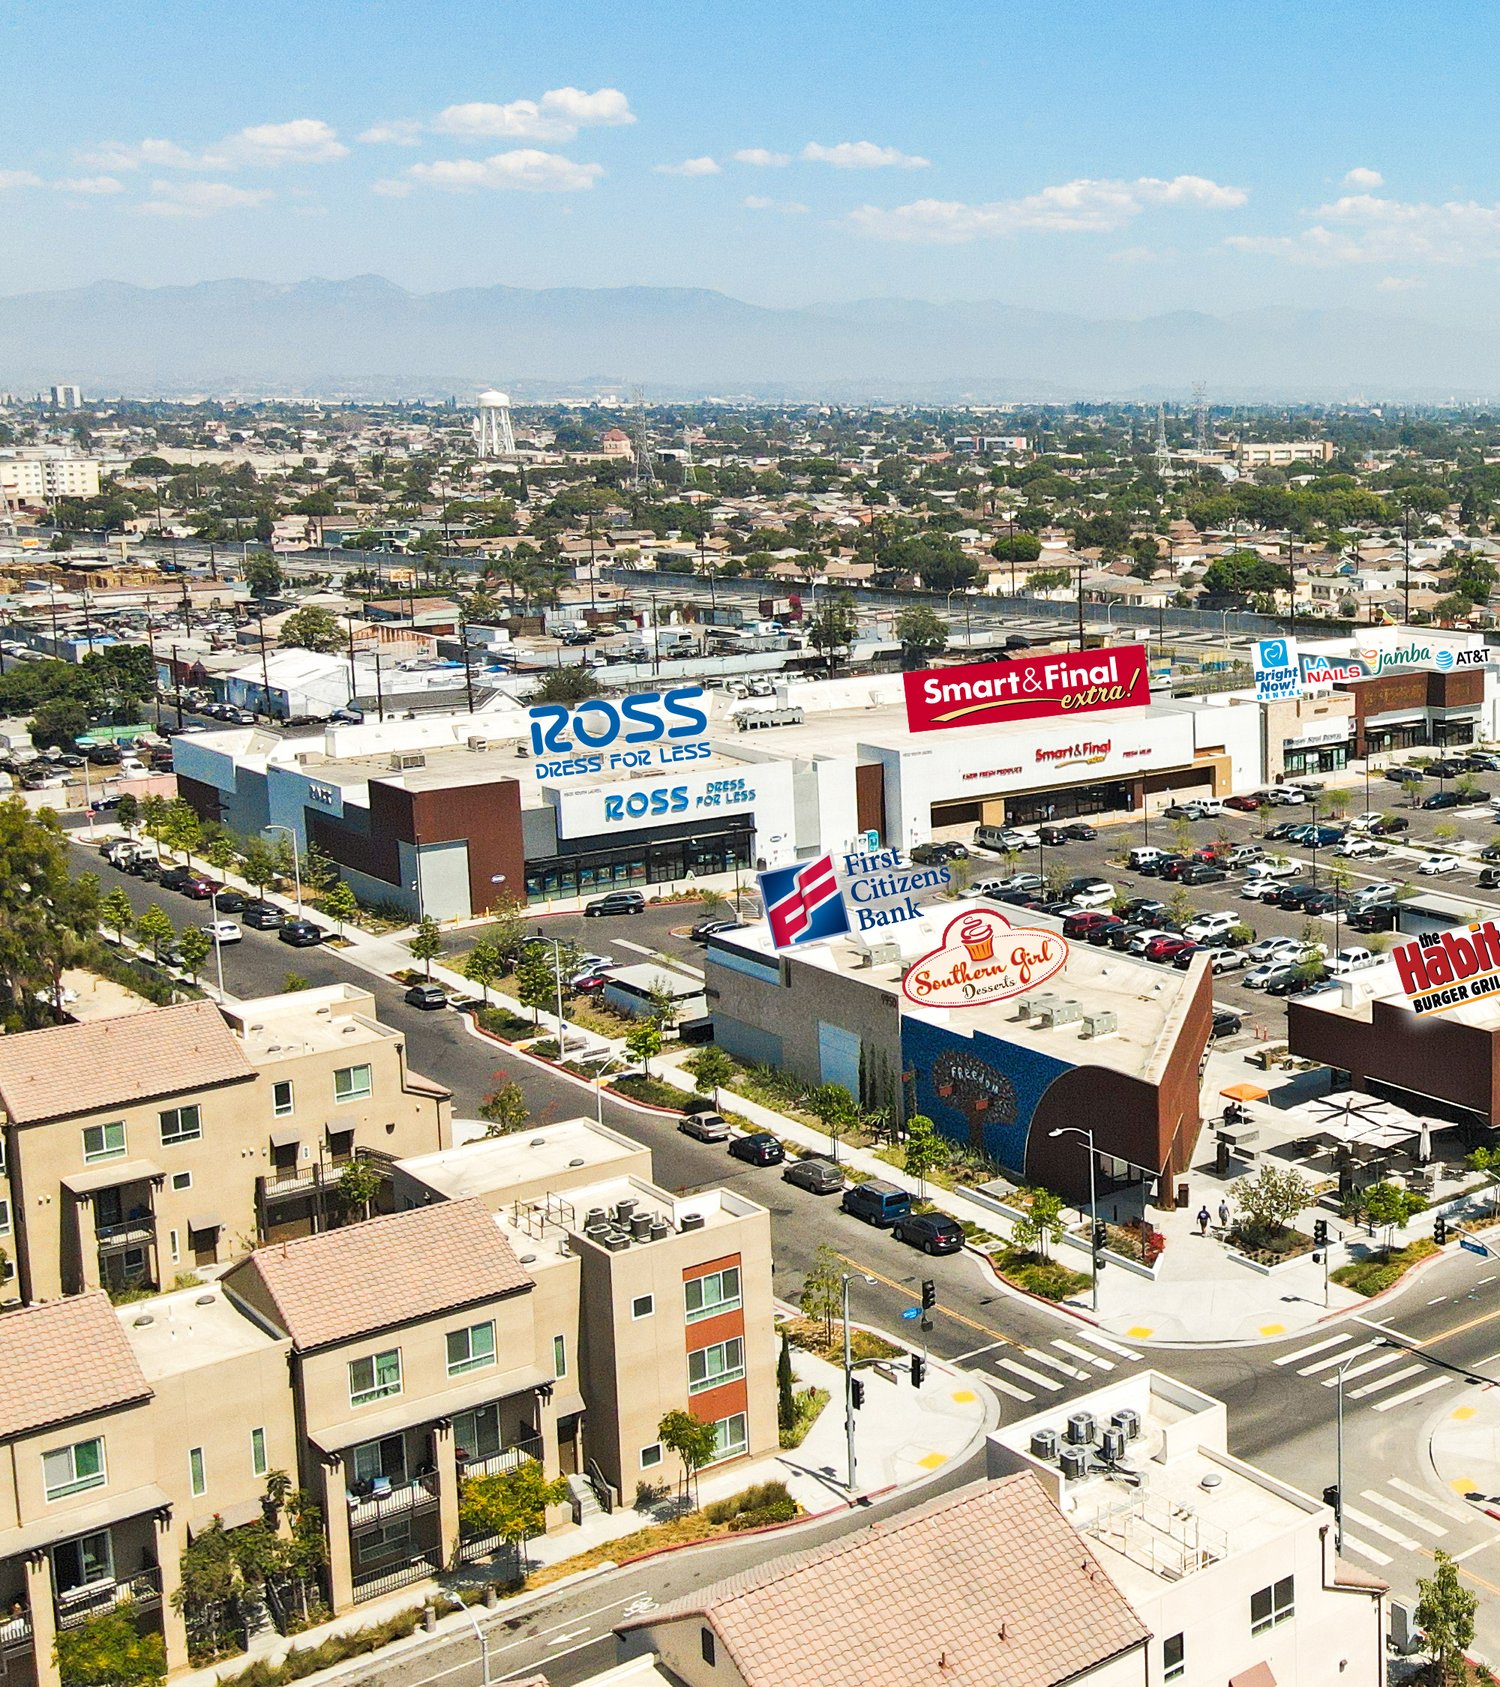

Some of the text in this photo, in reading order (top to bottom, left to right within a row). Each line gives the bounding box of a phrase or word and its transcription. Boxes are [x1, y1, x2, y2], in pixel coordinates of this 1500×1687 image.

[706, 778, 745, 792] DRESS
[605, 785, 689, 822] ROSS
[696, 789, 756, 808] FOR LESS
